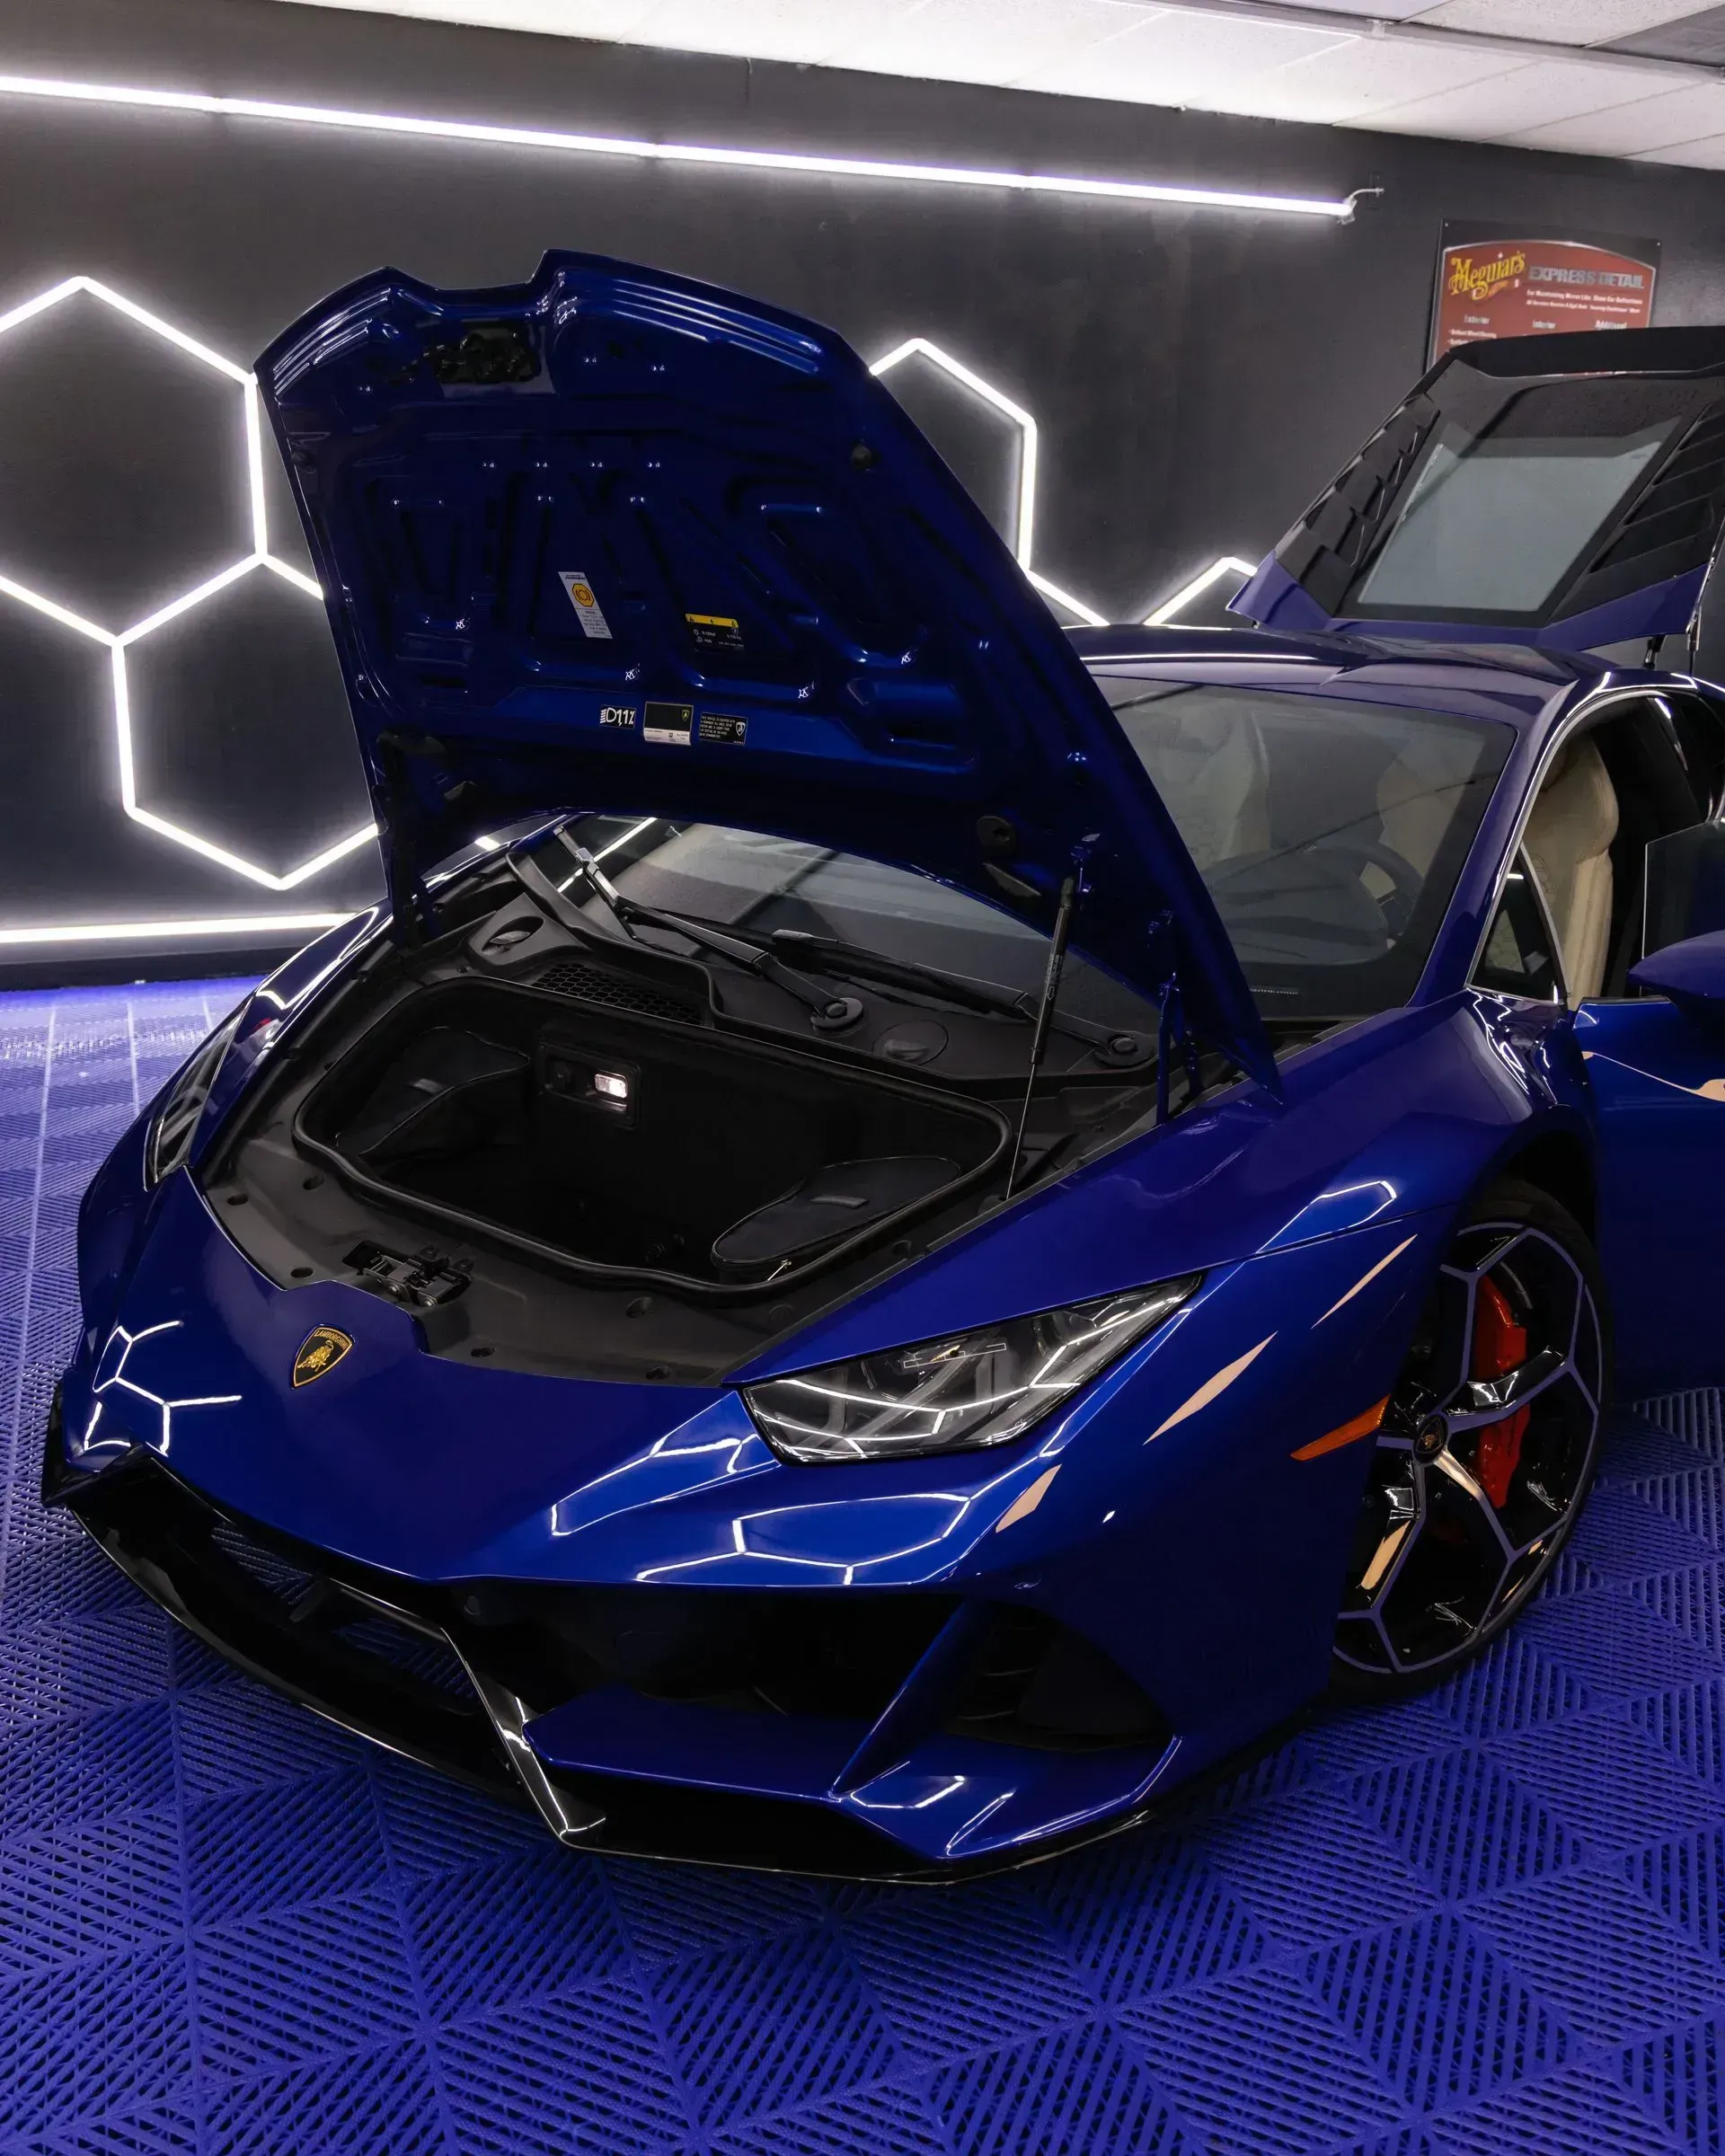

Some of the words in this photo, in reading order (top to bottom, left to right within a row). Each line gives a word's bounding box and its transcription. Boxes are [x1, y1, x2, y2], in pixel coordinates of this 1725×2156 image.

[1448, 250, 1526, 300] Meguiar's
[1528, 266, 1596, 285] EXPRESS
[1598, 272, 1644, 288] DETAIL
[314, 1330, 349, 1350] LAMBORGHINI
